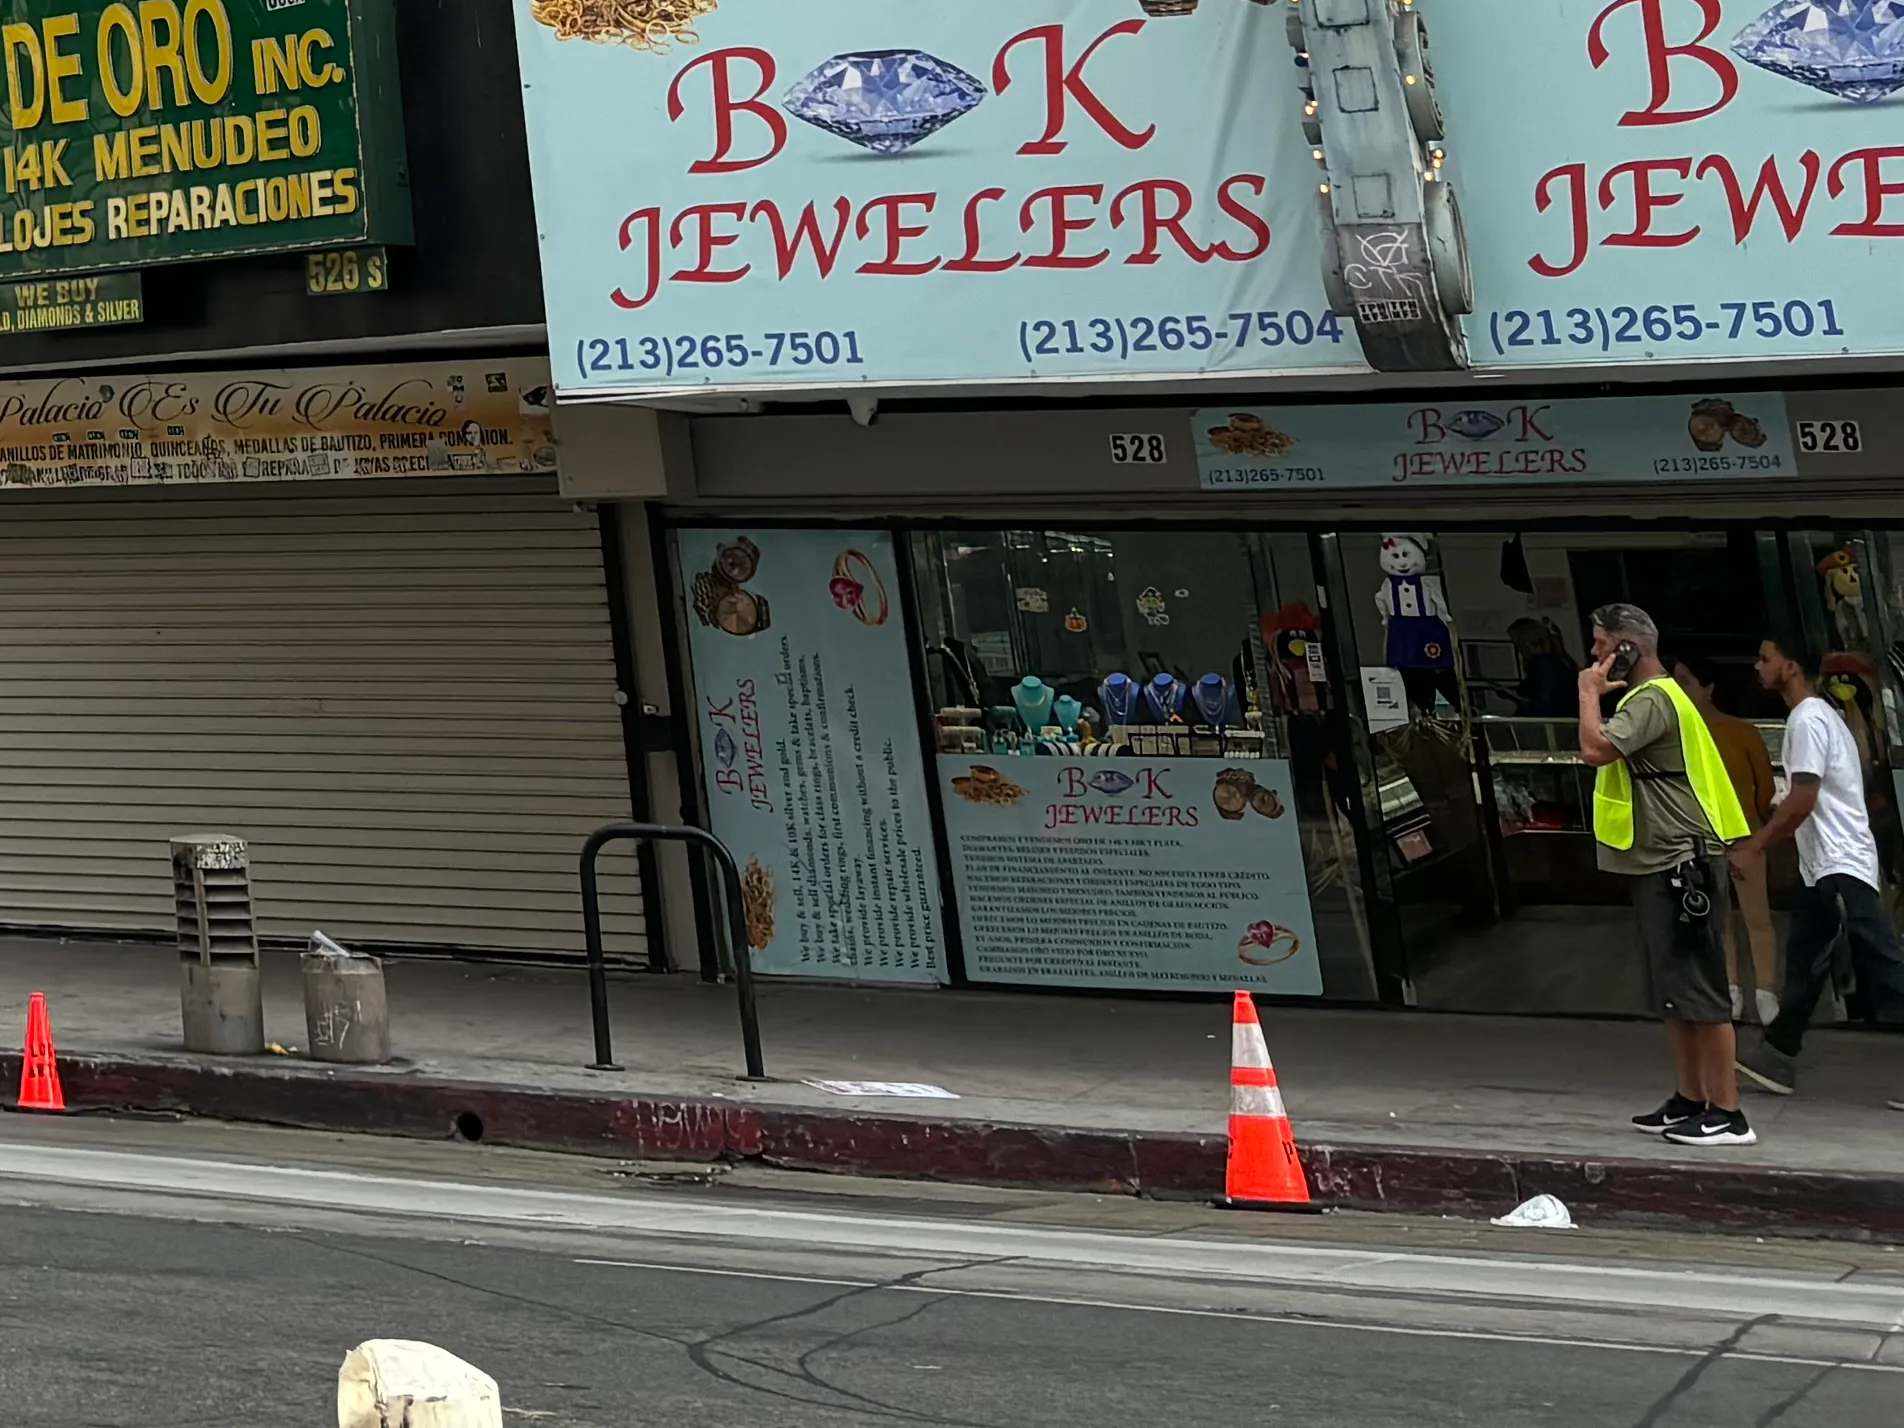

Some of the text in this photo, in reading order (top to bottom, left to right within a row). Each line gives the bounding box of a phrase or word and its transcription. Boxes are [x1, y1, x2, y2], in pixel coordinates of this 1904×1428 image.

[2, 12, 90, 131] DE
[251, 27, 347, 96] INC.
[3, 136, 74, 194] 14K
[93, 104, 322, 183] MENUDEO
[107, 167, 359, 240] REPARACIONES
[609, 172, 1273, 311] JEWELERS
[309, 254, 361, 292] 526
[14, 278, 101, 308] WE BUY
[17, 305, 82, 331] DIAMONDS
[85, 304, 95, 324] &
[97, 299, 141, 323] SILVER
[1018, 307, 1344, 360] (213)265-7504
[1489, 297, 1847, 351] (213)265-7501
[575, 328, 865, 376] (213)265-7501
[292, 379, 448, 431] Palacio
[0, 445, 46, 463] ANILLOS
[50, 444, 64, 461] DE
[319, 433, 377, 453] BAUTIZO,
[1112, 435, 1165, 463] 528
[1799, 423, 1861, 452] 528
[1209, 467, 1326, 485] (213)265-7501
[1392, 447, 1588, 483] JEWELERS
[1653, 454, 1782, 474] (213)265-7504
[788, 712, 799, 734] take
[736, 677, 774, 814] JEWELERS
[779, 768, 791, 788] and
[887, 779, 898, 796] the
[817, 824, 828, 839] for
[831, 818, 843, 839] first
[849, 720, 889, 947] provide instant financing without credit
[893, 812, 907, 845] prices
[1045, 804, 1199, 830] JEWELERS
[898, 849, 911, 902] wholesale
[859, 904, 874, 945] provide
[884, 868, 904, 947] provide repair
[903, 906, 920, 948] provide
[923, 916, 936, 968] Best price
